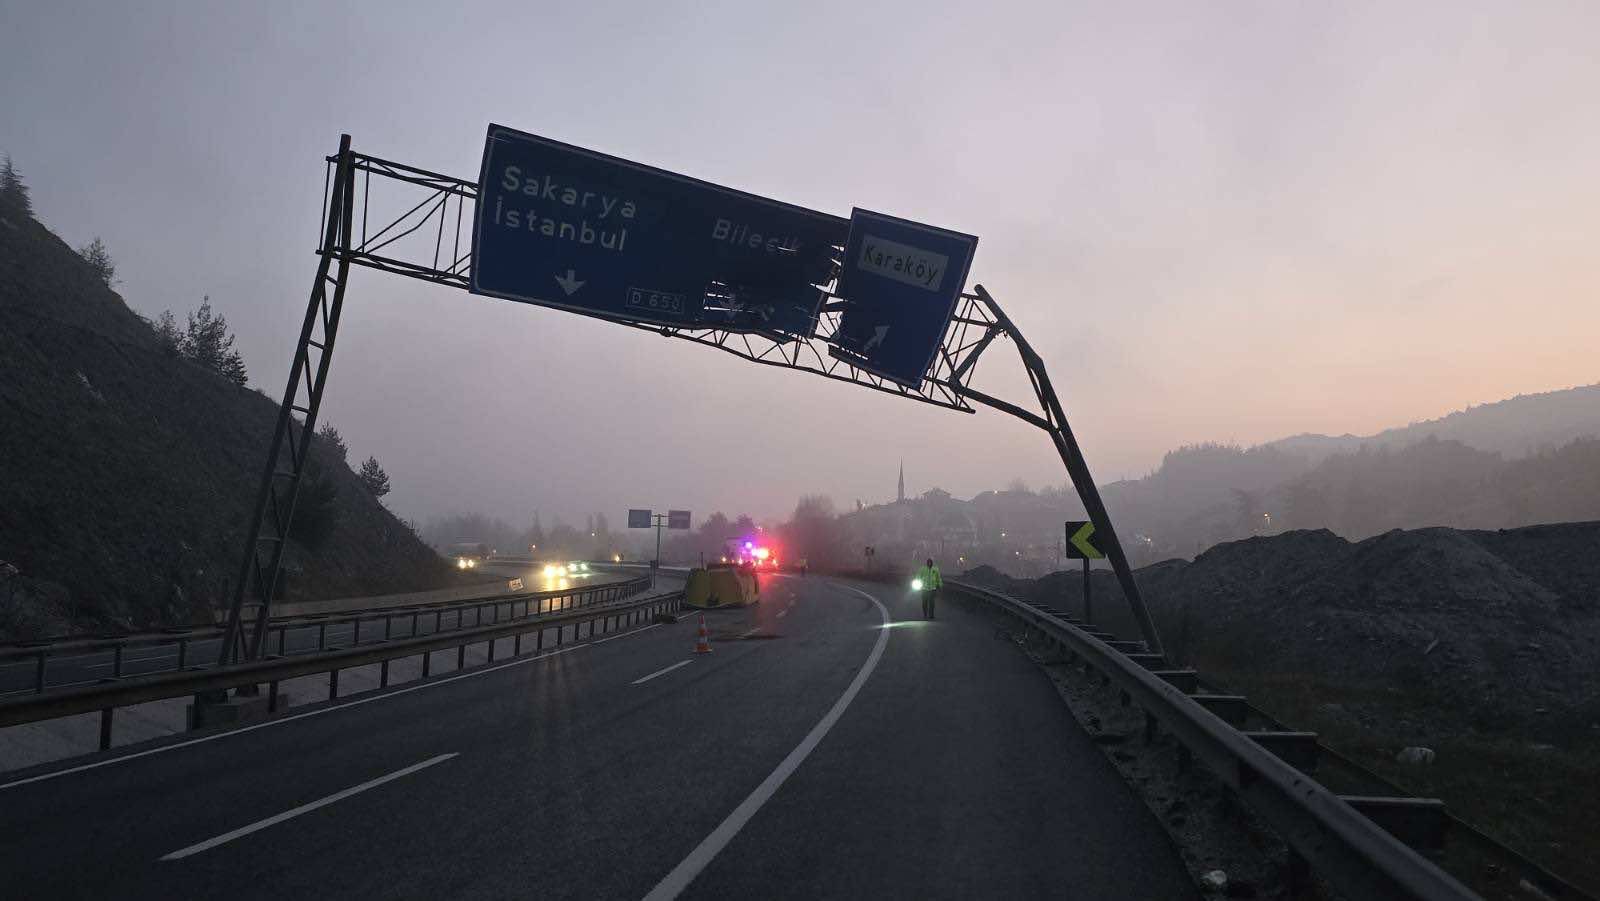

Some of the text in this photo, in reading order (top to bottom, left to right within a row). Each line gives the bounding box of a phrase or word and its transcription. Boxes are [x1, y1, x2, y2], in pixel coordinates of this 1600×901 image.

[502, 165, 637, 221] Sakarya
[493, 197, 629, 252] İstanbul
[863, 244, 940, 287] Karaköy
[630, 290, 641, 304] D
